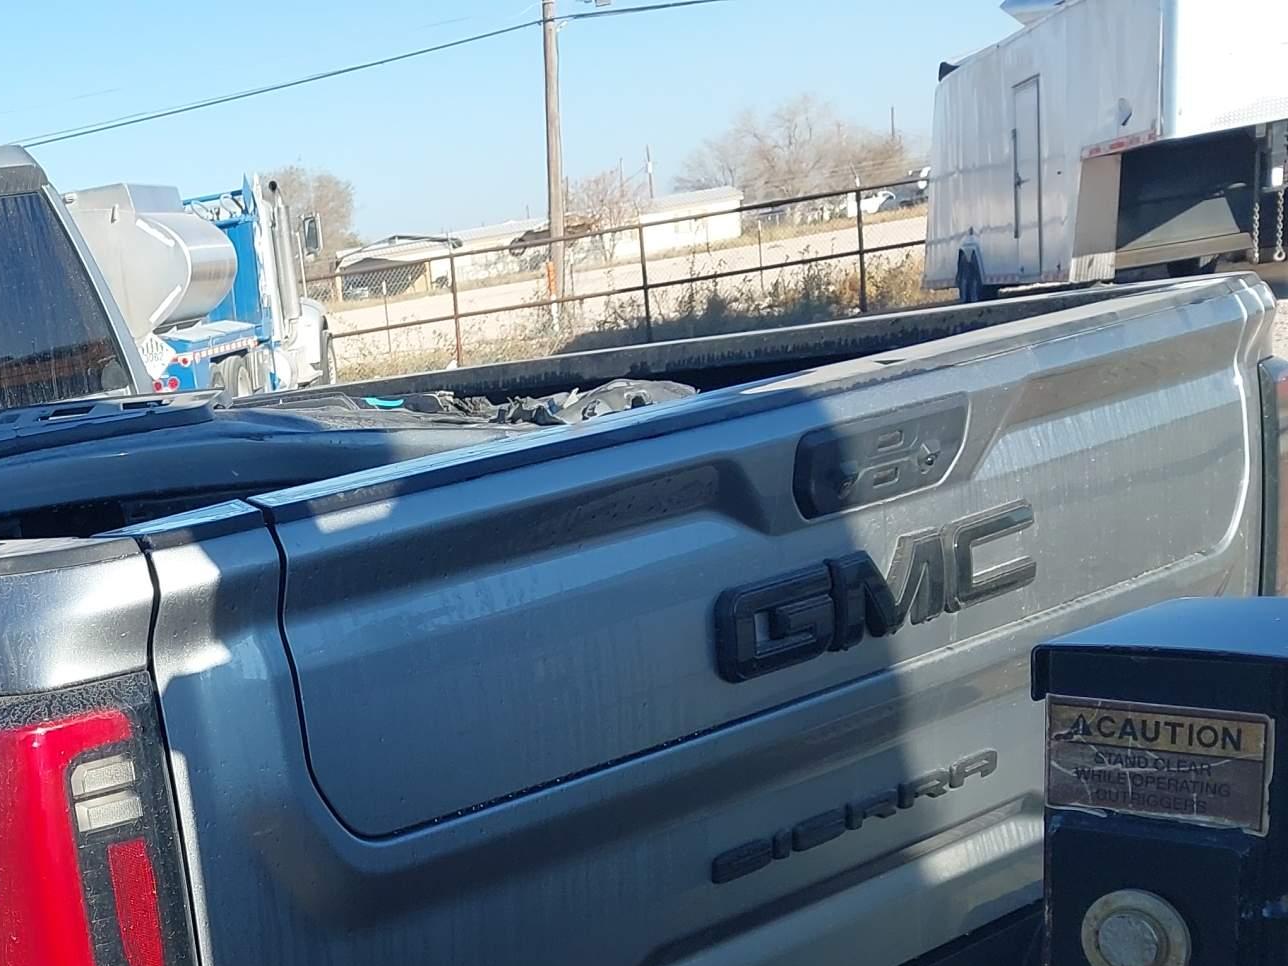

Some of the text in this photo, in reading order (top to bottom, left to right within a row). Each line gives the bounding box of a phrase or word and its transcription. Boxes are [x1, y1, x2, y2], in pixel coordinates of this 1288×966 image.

[712, 499, 1036, 683] GMC
[1097, 716, 1242, 751] CAUTION
[1132, 773, 1231, 798] OPERATING
